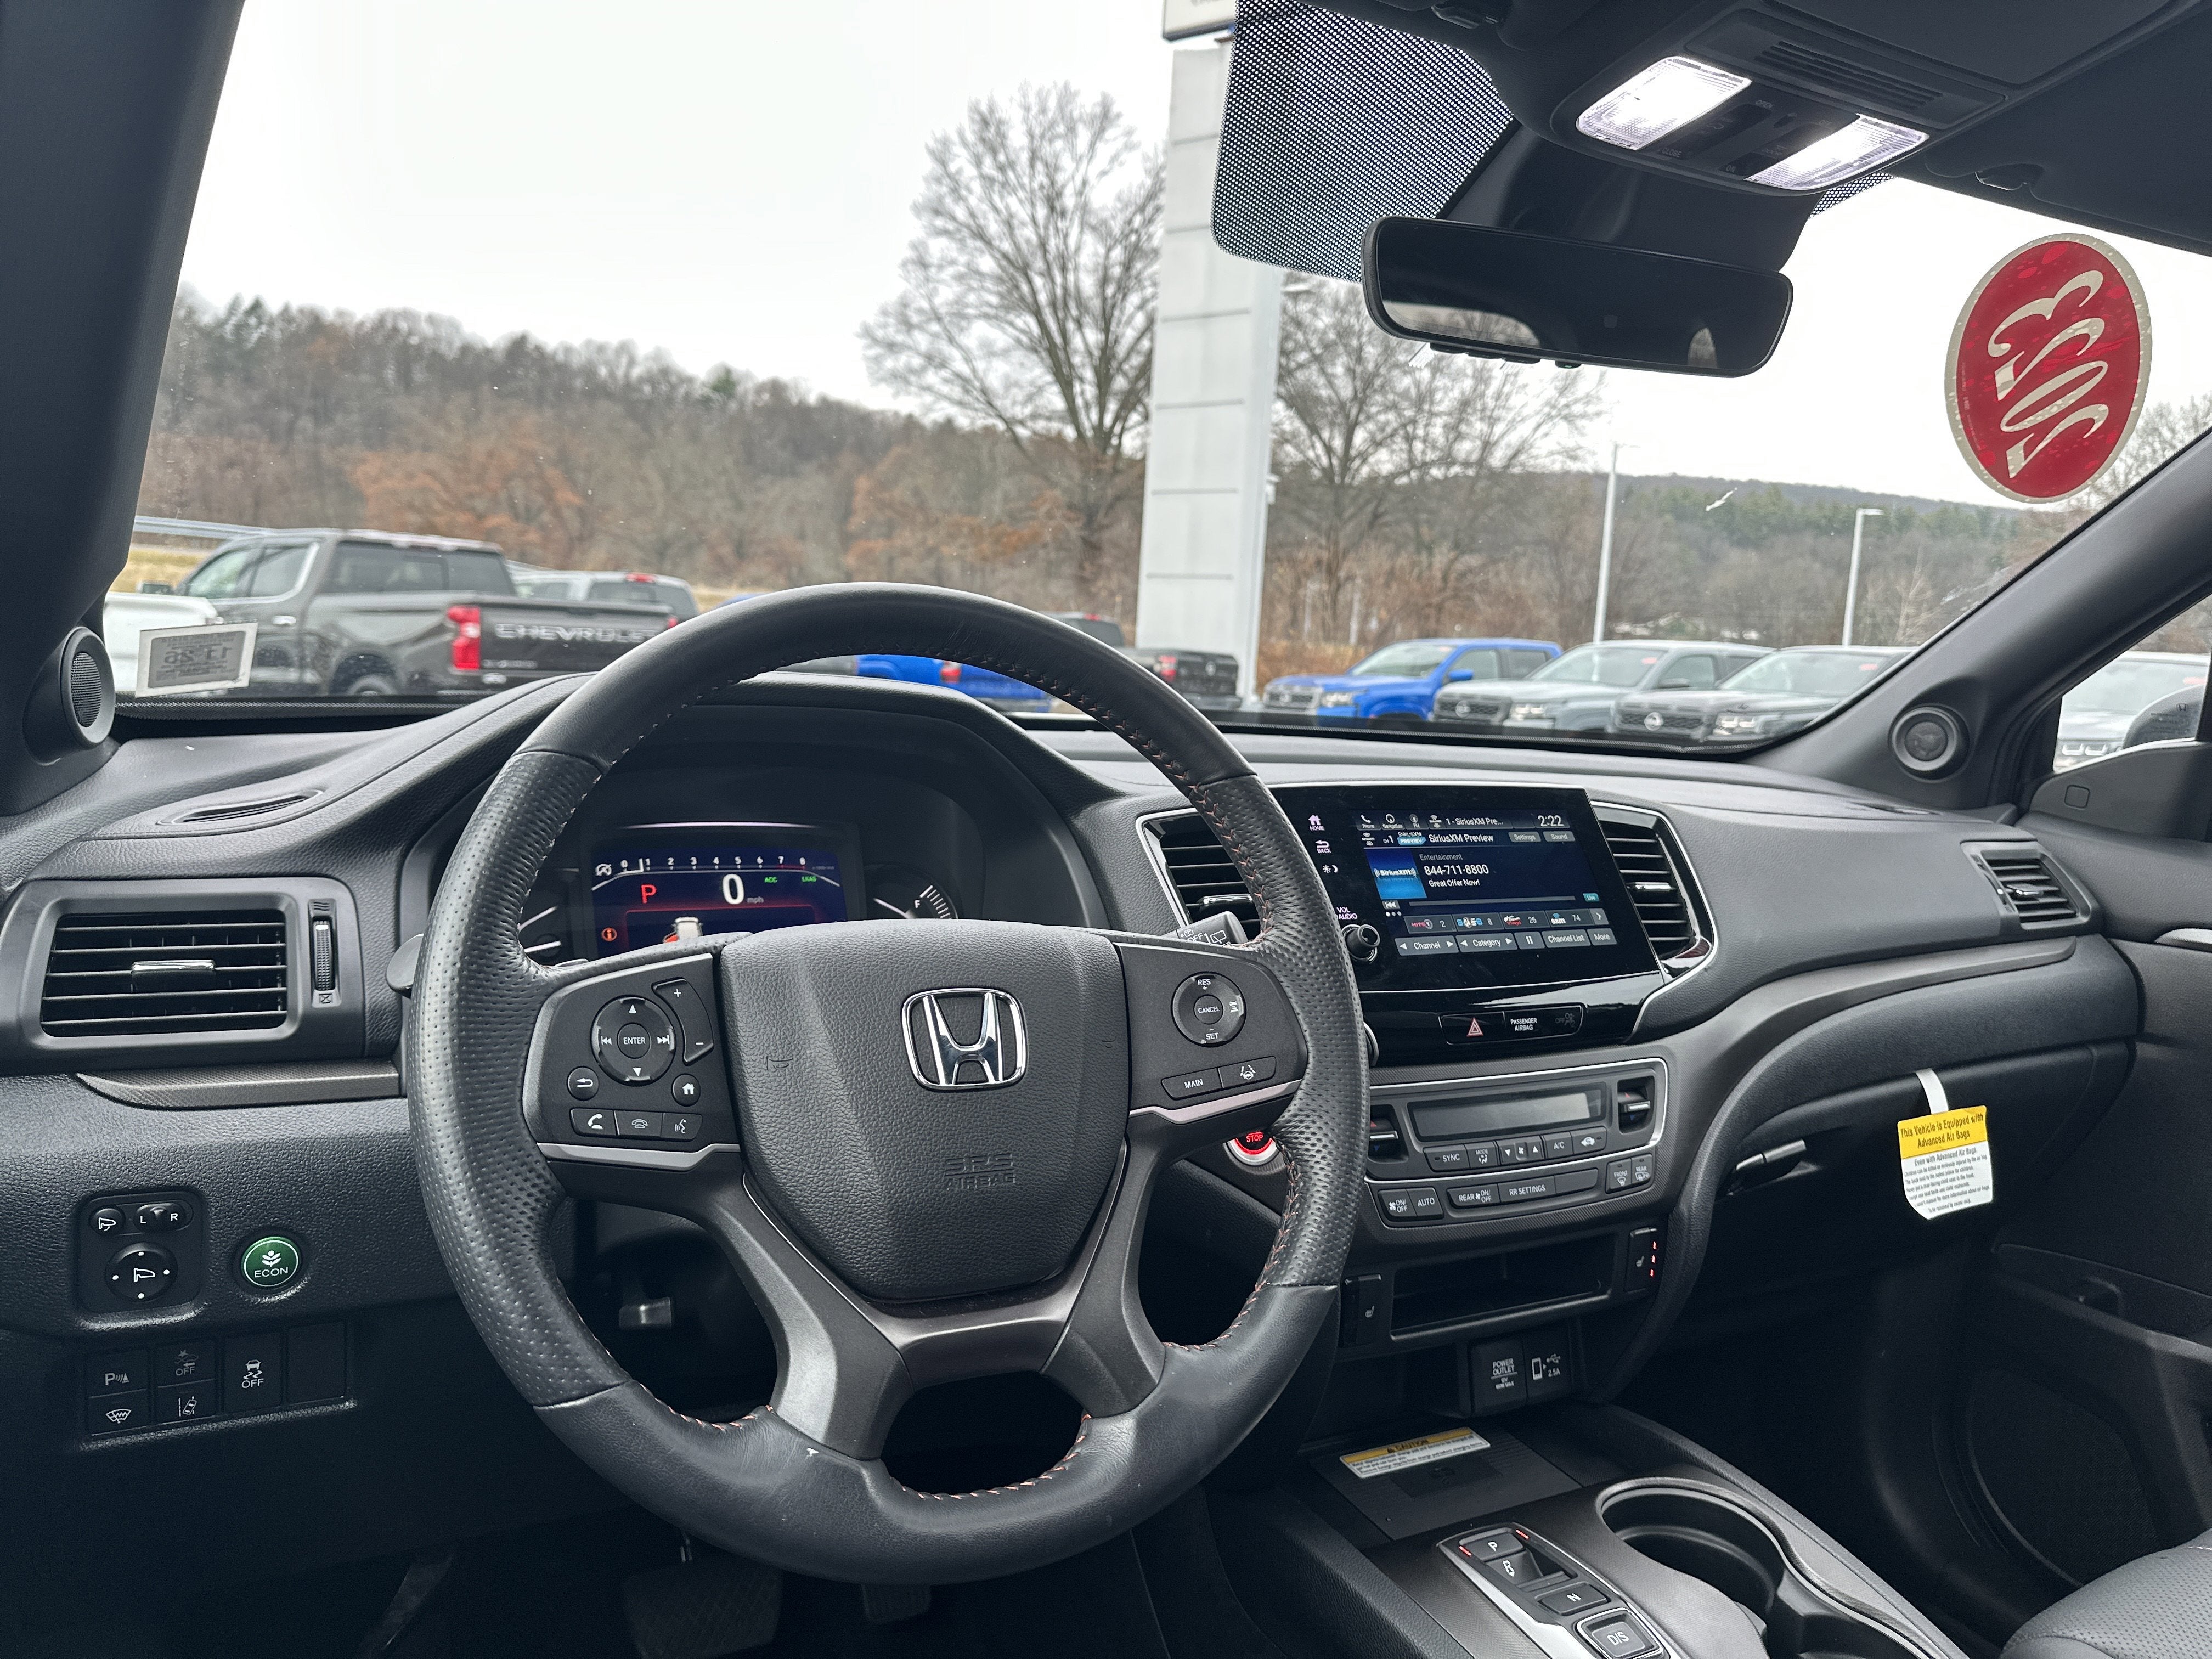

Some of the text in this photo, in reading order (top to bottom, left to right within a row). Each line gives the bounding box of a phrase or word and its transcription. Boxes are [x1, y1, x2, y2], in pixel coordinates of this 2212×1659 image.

[1455, 817, 1485, 826] SiriusXM
[1538, 815, 1564, 827] 2:22
[1429, 833, 1493, 843] SiriusXM Preview
[1424, 864, 1489, 876] 844-711-8800
[1429, 879, 1447, 887] Great
[641, 884, 657, 904] P
[722, 873, 764, 905] 0 mph
[915, 900, 920, 909] F
[1548, 935, 1573, 943] Channel
[1593, 933, 1610, 941] More
[1414, 941, 1441, 950] Channel
[1472, 939, 1501, 947] Category
[1184, 1079, 1204, 1089] MAIN
[1900, 1128, 1913, 1138] This
[1914, 1124, 1936, 1136] Vehicle
[1943, 1115, 1970, 1130] Equipped
[1970, 1113, 1983, 1124] with
[1246, 1134, 1263, 1143] STOP
[1917, 1133, 1945, 1148] Advanced
[1956, 1130, 1970, 1140] Bags
[1553, 1141, 1564, 1150] A/C
[1442, 1153, 1460, 1163] SYNC
[1914, 1158, 1925, 1166] Even
[1926, 1155, 1936, 1163] with
[1936, 1151, 1958, 1161] Advanced
[1518, 1184, 1546, 1195] SETTINGS
[1418, 1197, 1435, 1207] AUTO
[1459, 1193, 1475, 1201] REAR
[140, 1212, 178, 1224] L R
[254, 1267, 289, 1278] ECON
[1493, 1358, 1514, 1368] POWER
[176, 1365, 195, 1376] OFF
[1493, 1364, 1514, 1376] OUTLET
[241, 1378, 264, 1388] OFF
[1488, 1541, 1498, 1551] P
[1503, 1560, 1513, 1572] R
[1566, 1593, 1581, 1602] N
[1606, 1632, 1629, 1645] D/S
